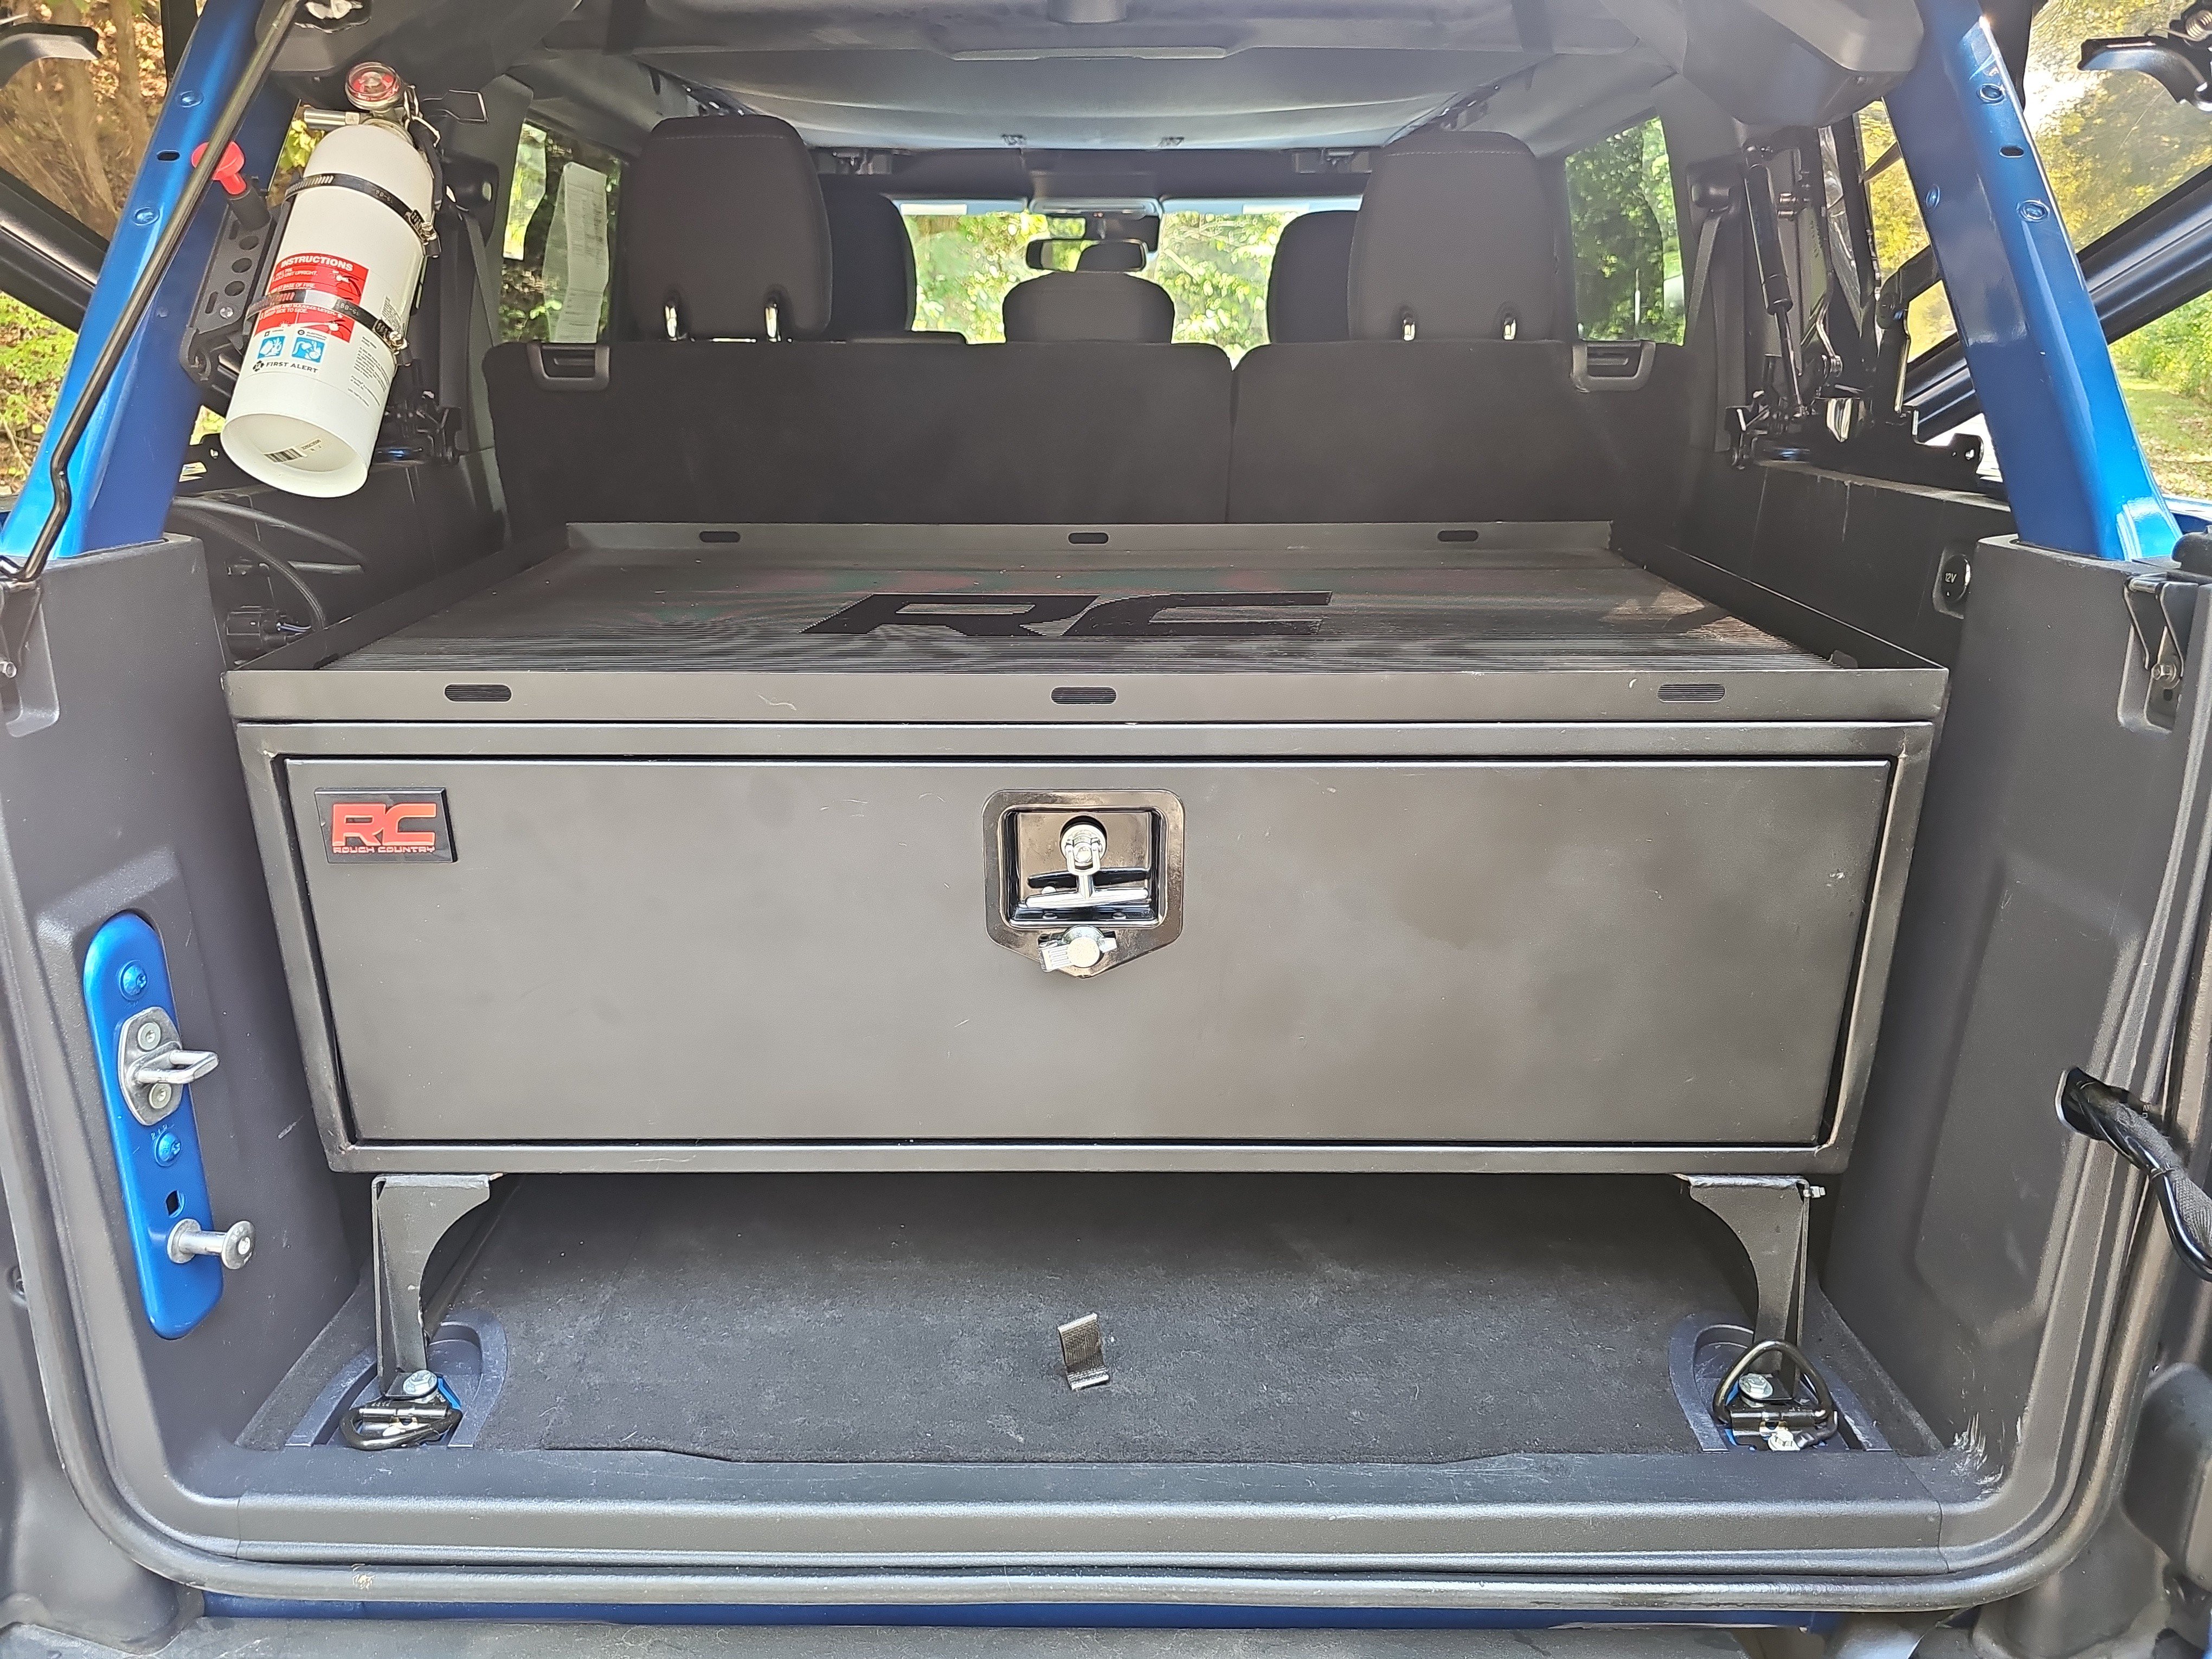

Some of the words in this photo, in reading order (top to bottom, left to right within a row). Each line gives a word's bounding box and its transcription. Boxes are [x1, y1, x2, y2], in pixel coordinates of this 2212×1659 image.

[280, 255, 354, 272] INSTRUCTIONS
[290, 363, 319, 374] ALERT
[1945, 572, 1957, 583] 12V
[799, 590, 1334, 636] RC
[332, 802, 436, 846] RC
